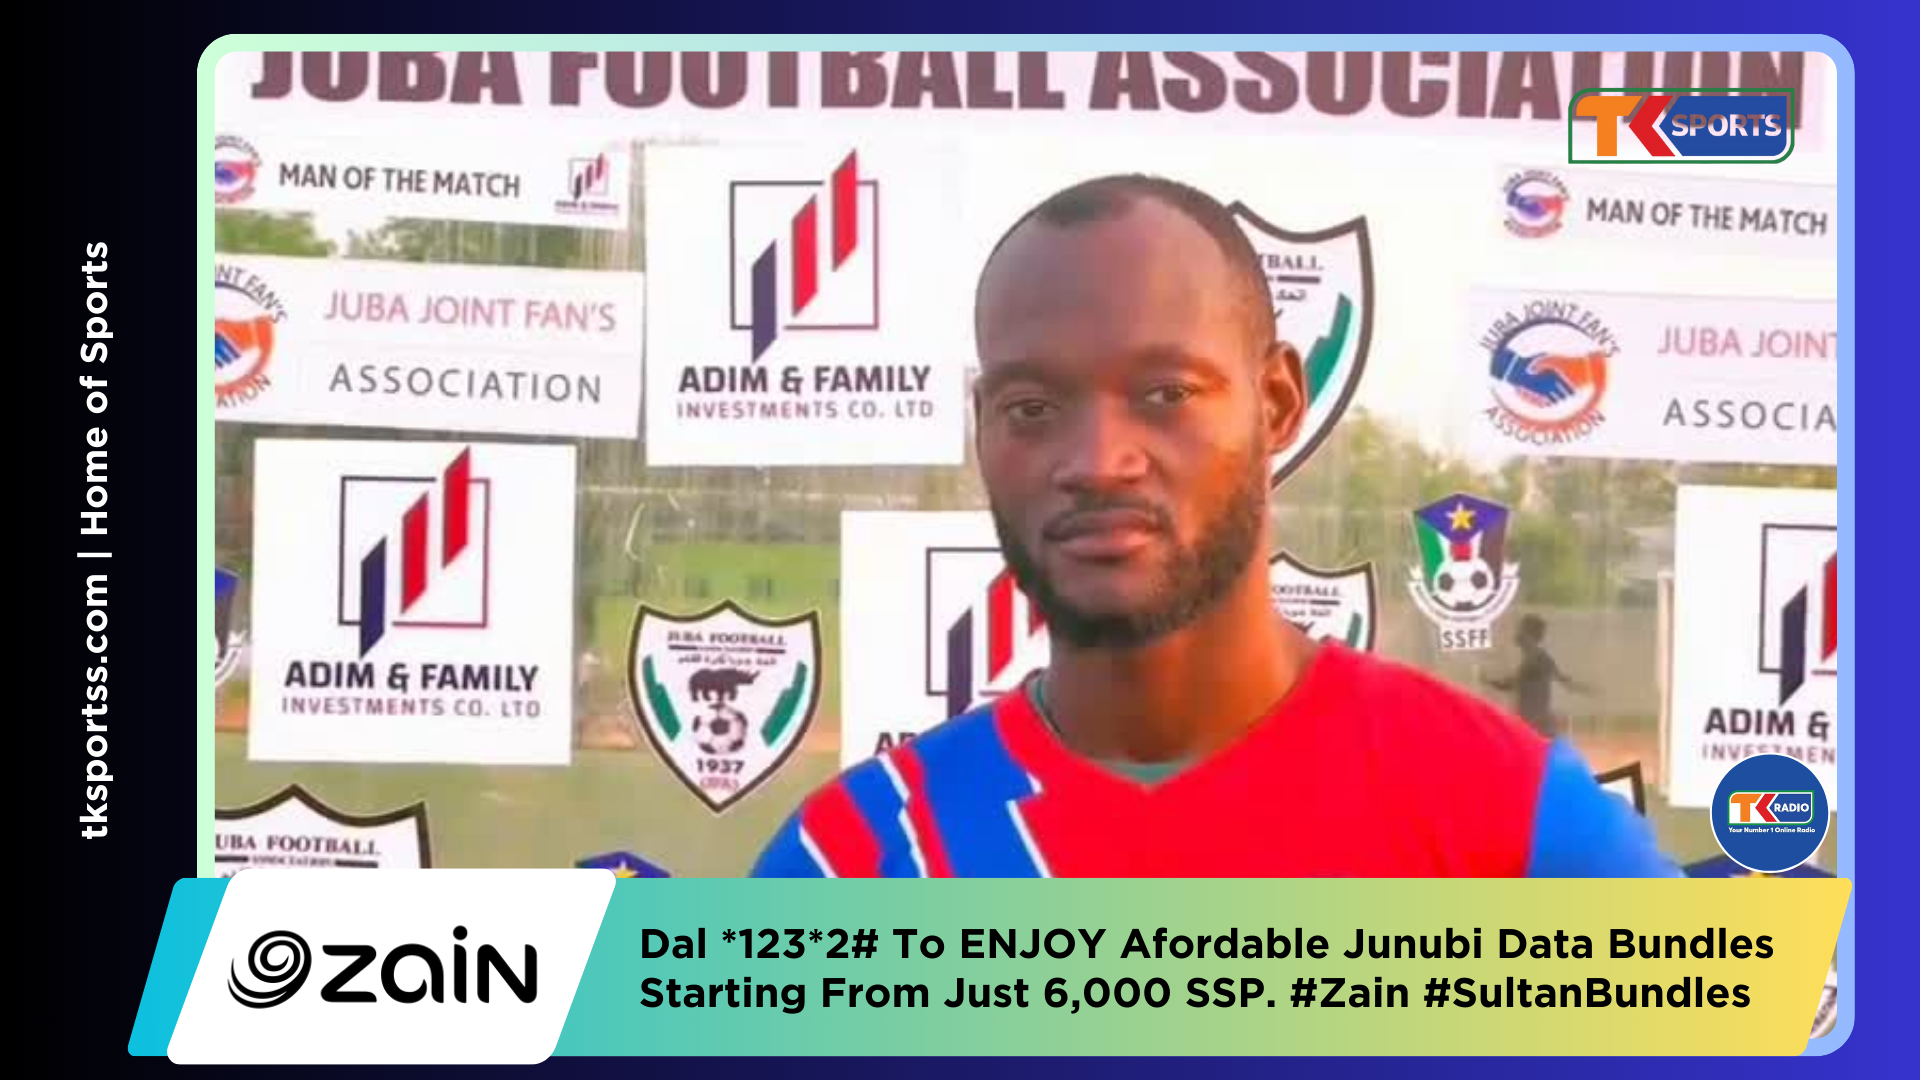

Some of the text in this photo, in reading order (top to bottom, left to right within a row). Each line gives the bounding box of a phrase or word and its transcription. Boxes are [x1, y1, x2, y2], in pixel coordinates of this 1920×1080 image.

[279, 162, 520, 199] MAN OF THE MATCH
[1586, 197, 1828, 236] MAN OF THE MATCH
[324, 291, 616, 332] JUBA JOINT FAN'S
[1480, 311, 1519, 350] JUBA
[1523, 299, 1579, 321] JOINT
[1656, 326, 1743, 357] JUBA
[329, 364, 601, 403] ASSOCIATION
[678, 365, 931, 395] ADIM & FAMILY
[677, 400, 934, 419] INVESTMENTS CO. LTD
[1662, 397, 1836, 434] ASSOCIA
[1443, 629, 1488, 648] SSFF
[284, 661, 539, 695] ADIM & FAMILY
[282, 697, 541, 719] INVESTMENTS CO. LTD
[1704, 706, 1831, 743] ADIM &
[696, 758, 744, 775] 1937
[267, 835, 382, 856] FOOTBALL
